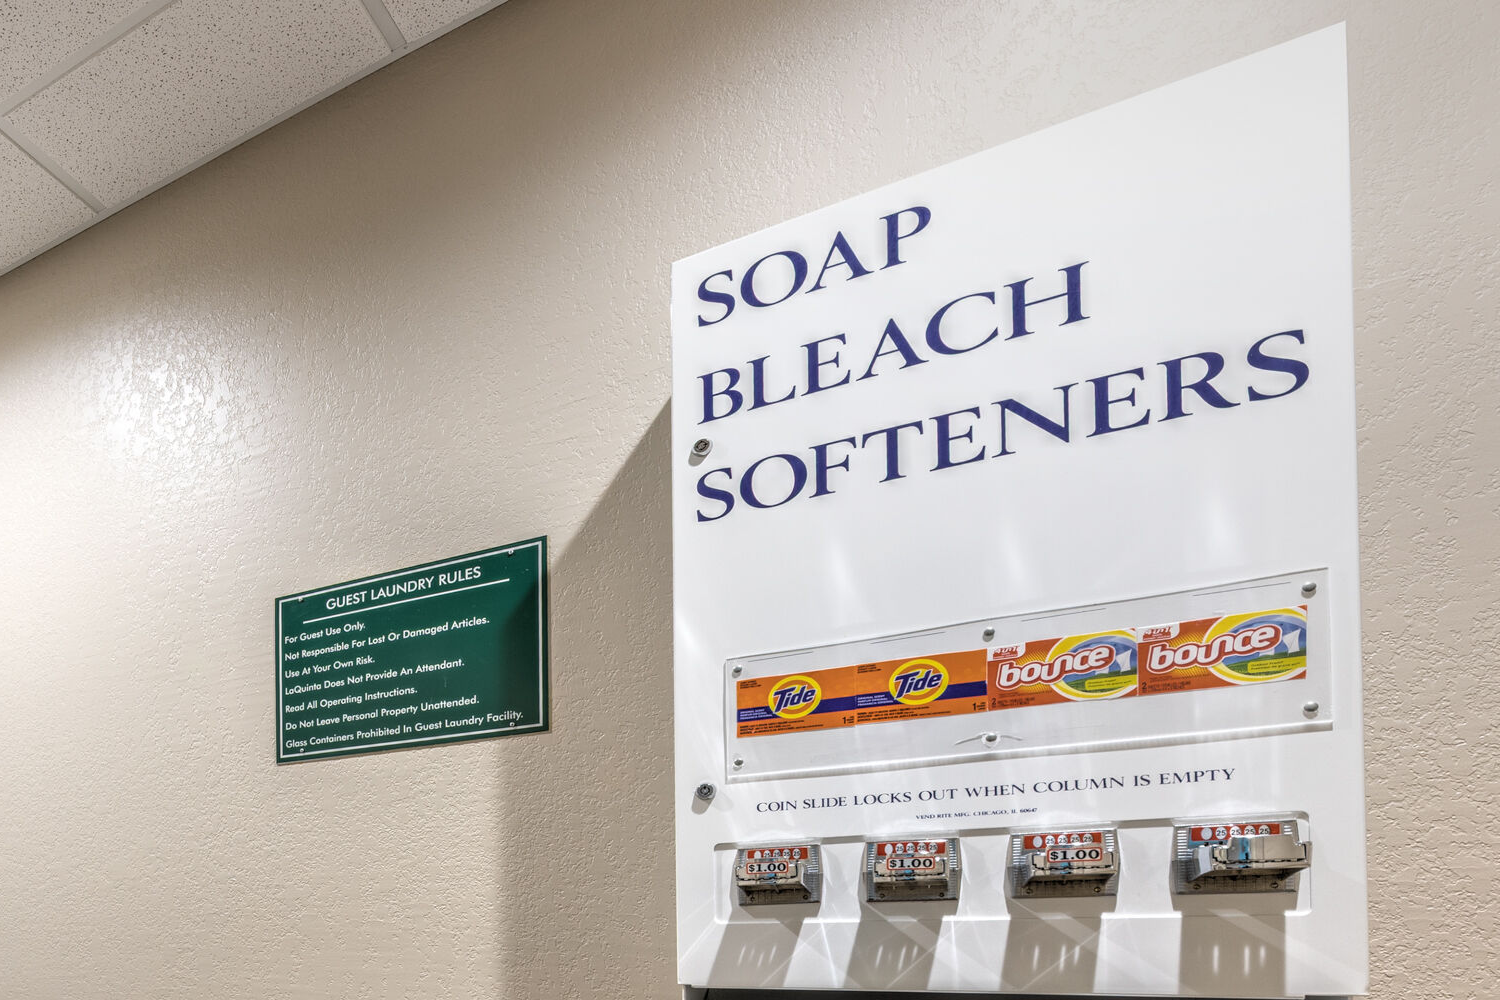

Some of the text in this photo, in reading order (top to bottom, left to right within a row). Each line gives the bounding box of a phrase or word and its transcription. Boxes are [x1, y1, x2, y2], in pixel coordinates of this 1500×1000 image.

[698, 206, 932, 327] SOAP
[697, 261, 1091, 425] BLEACH
[696, 329, 1310, 522] SOFTENERS
[326, 566, 481, 610] GUEST LAUNDRY RULES
[285, 622, 365, 644] For Guest Use Only.
[285, 616, 489, 661] Not Responsible For Lost Or Damaged Articles.
[1150, 625, 1277, 671] bounce
[285, 655, 375, 678] Use At Your Own Risk.
[286, 658, 464, 695] LaQuinta Does Not Provide An Attendant.
[894, 669, 943, 699] Tide
[999, 646, 1111, 688] bounce
[286, 686, 417, 713] Read All Operating Instructions.
[286, 695, 479, 730] Do Not Leave Personal Property Unattended.
[773, 685, 816, 713] Tide
[286, 710, 523, 748] Glass Containers Prohibited In Guest Laundry Facility.
[757, 768, 1235, 813] COIN SLIDE LOCKS OUT WHEN COLUMN IS EMPTY
[749, 863, 786, 872] $1.00
[890, 859, 932, 868] $1.00
[1050, 850, 1099, 860] $1.00
